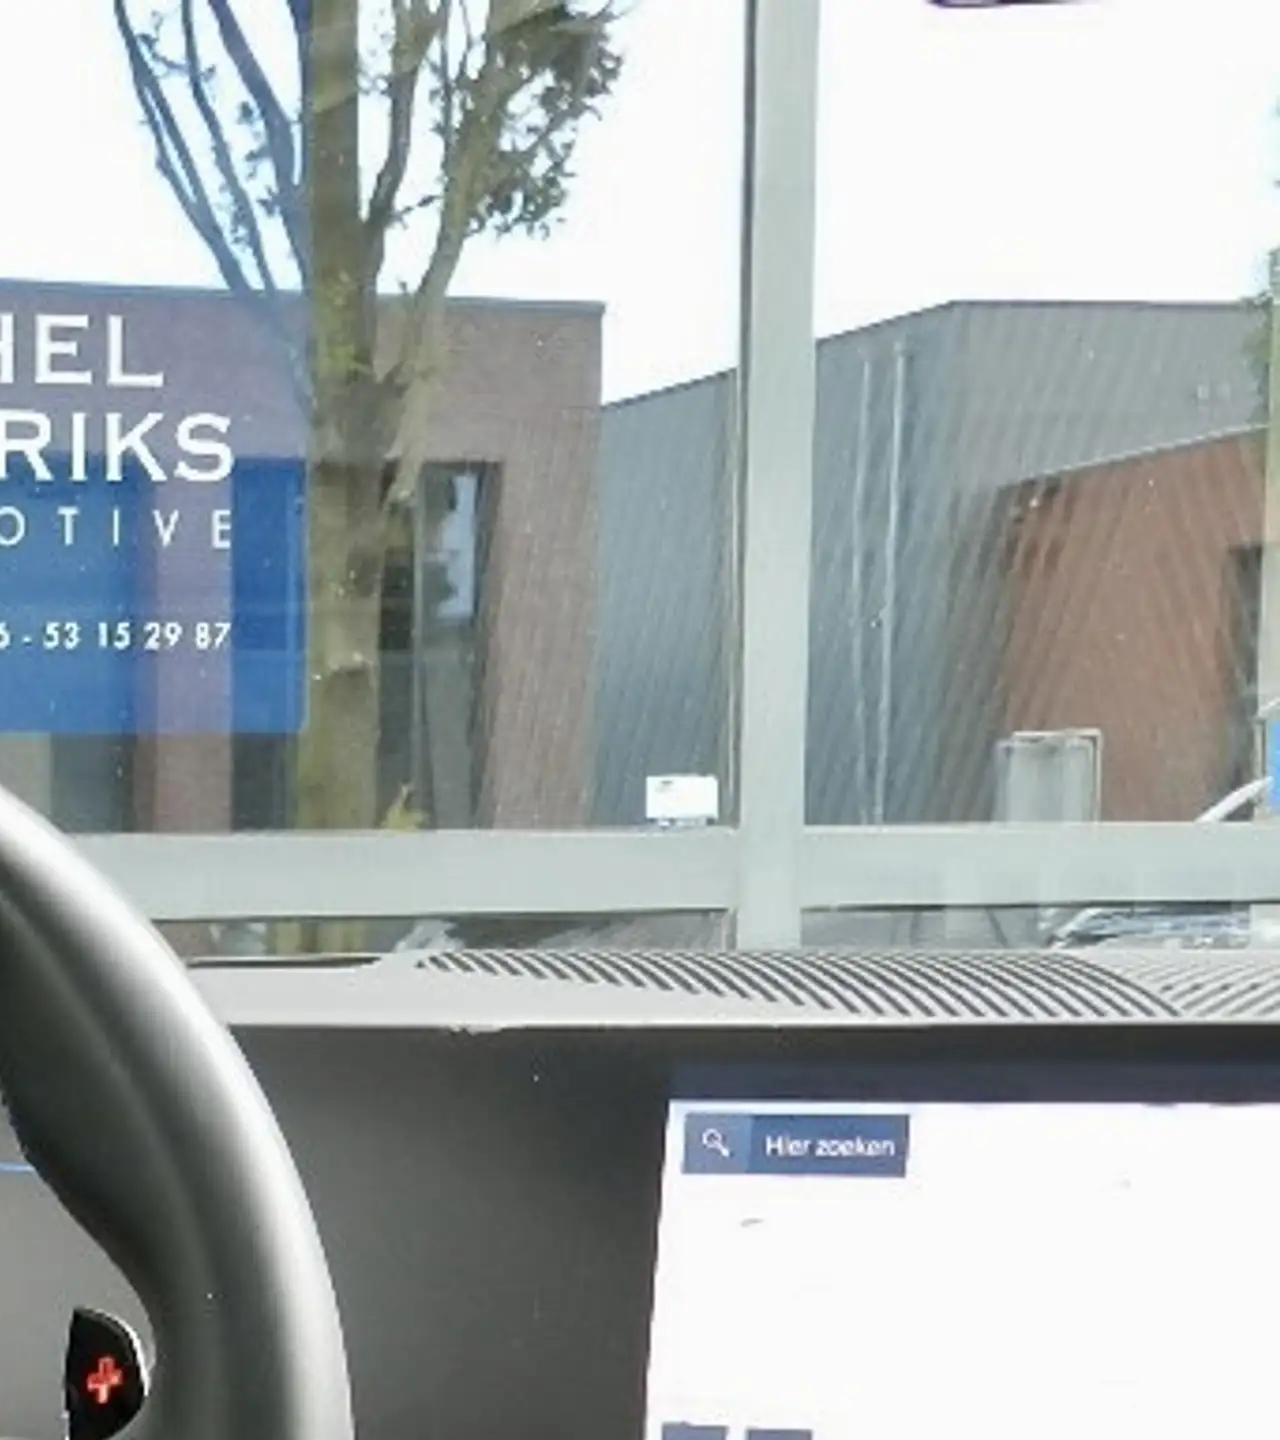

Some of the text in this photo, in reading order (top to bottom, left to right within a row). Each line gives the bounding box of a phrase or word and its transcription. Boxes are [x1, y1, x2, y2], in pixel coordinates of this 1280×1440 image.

[43, 620, 81, 650] 53
[97, 621, 131, 650] 15
[143, 621, 183, 650] 29
[195, 621, 232, 650] 87
[764, 1134, 896, 1159] Hier zoeken
